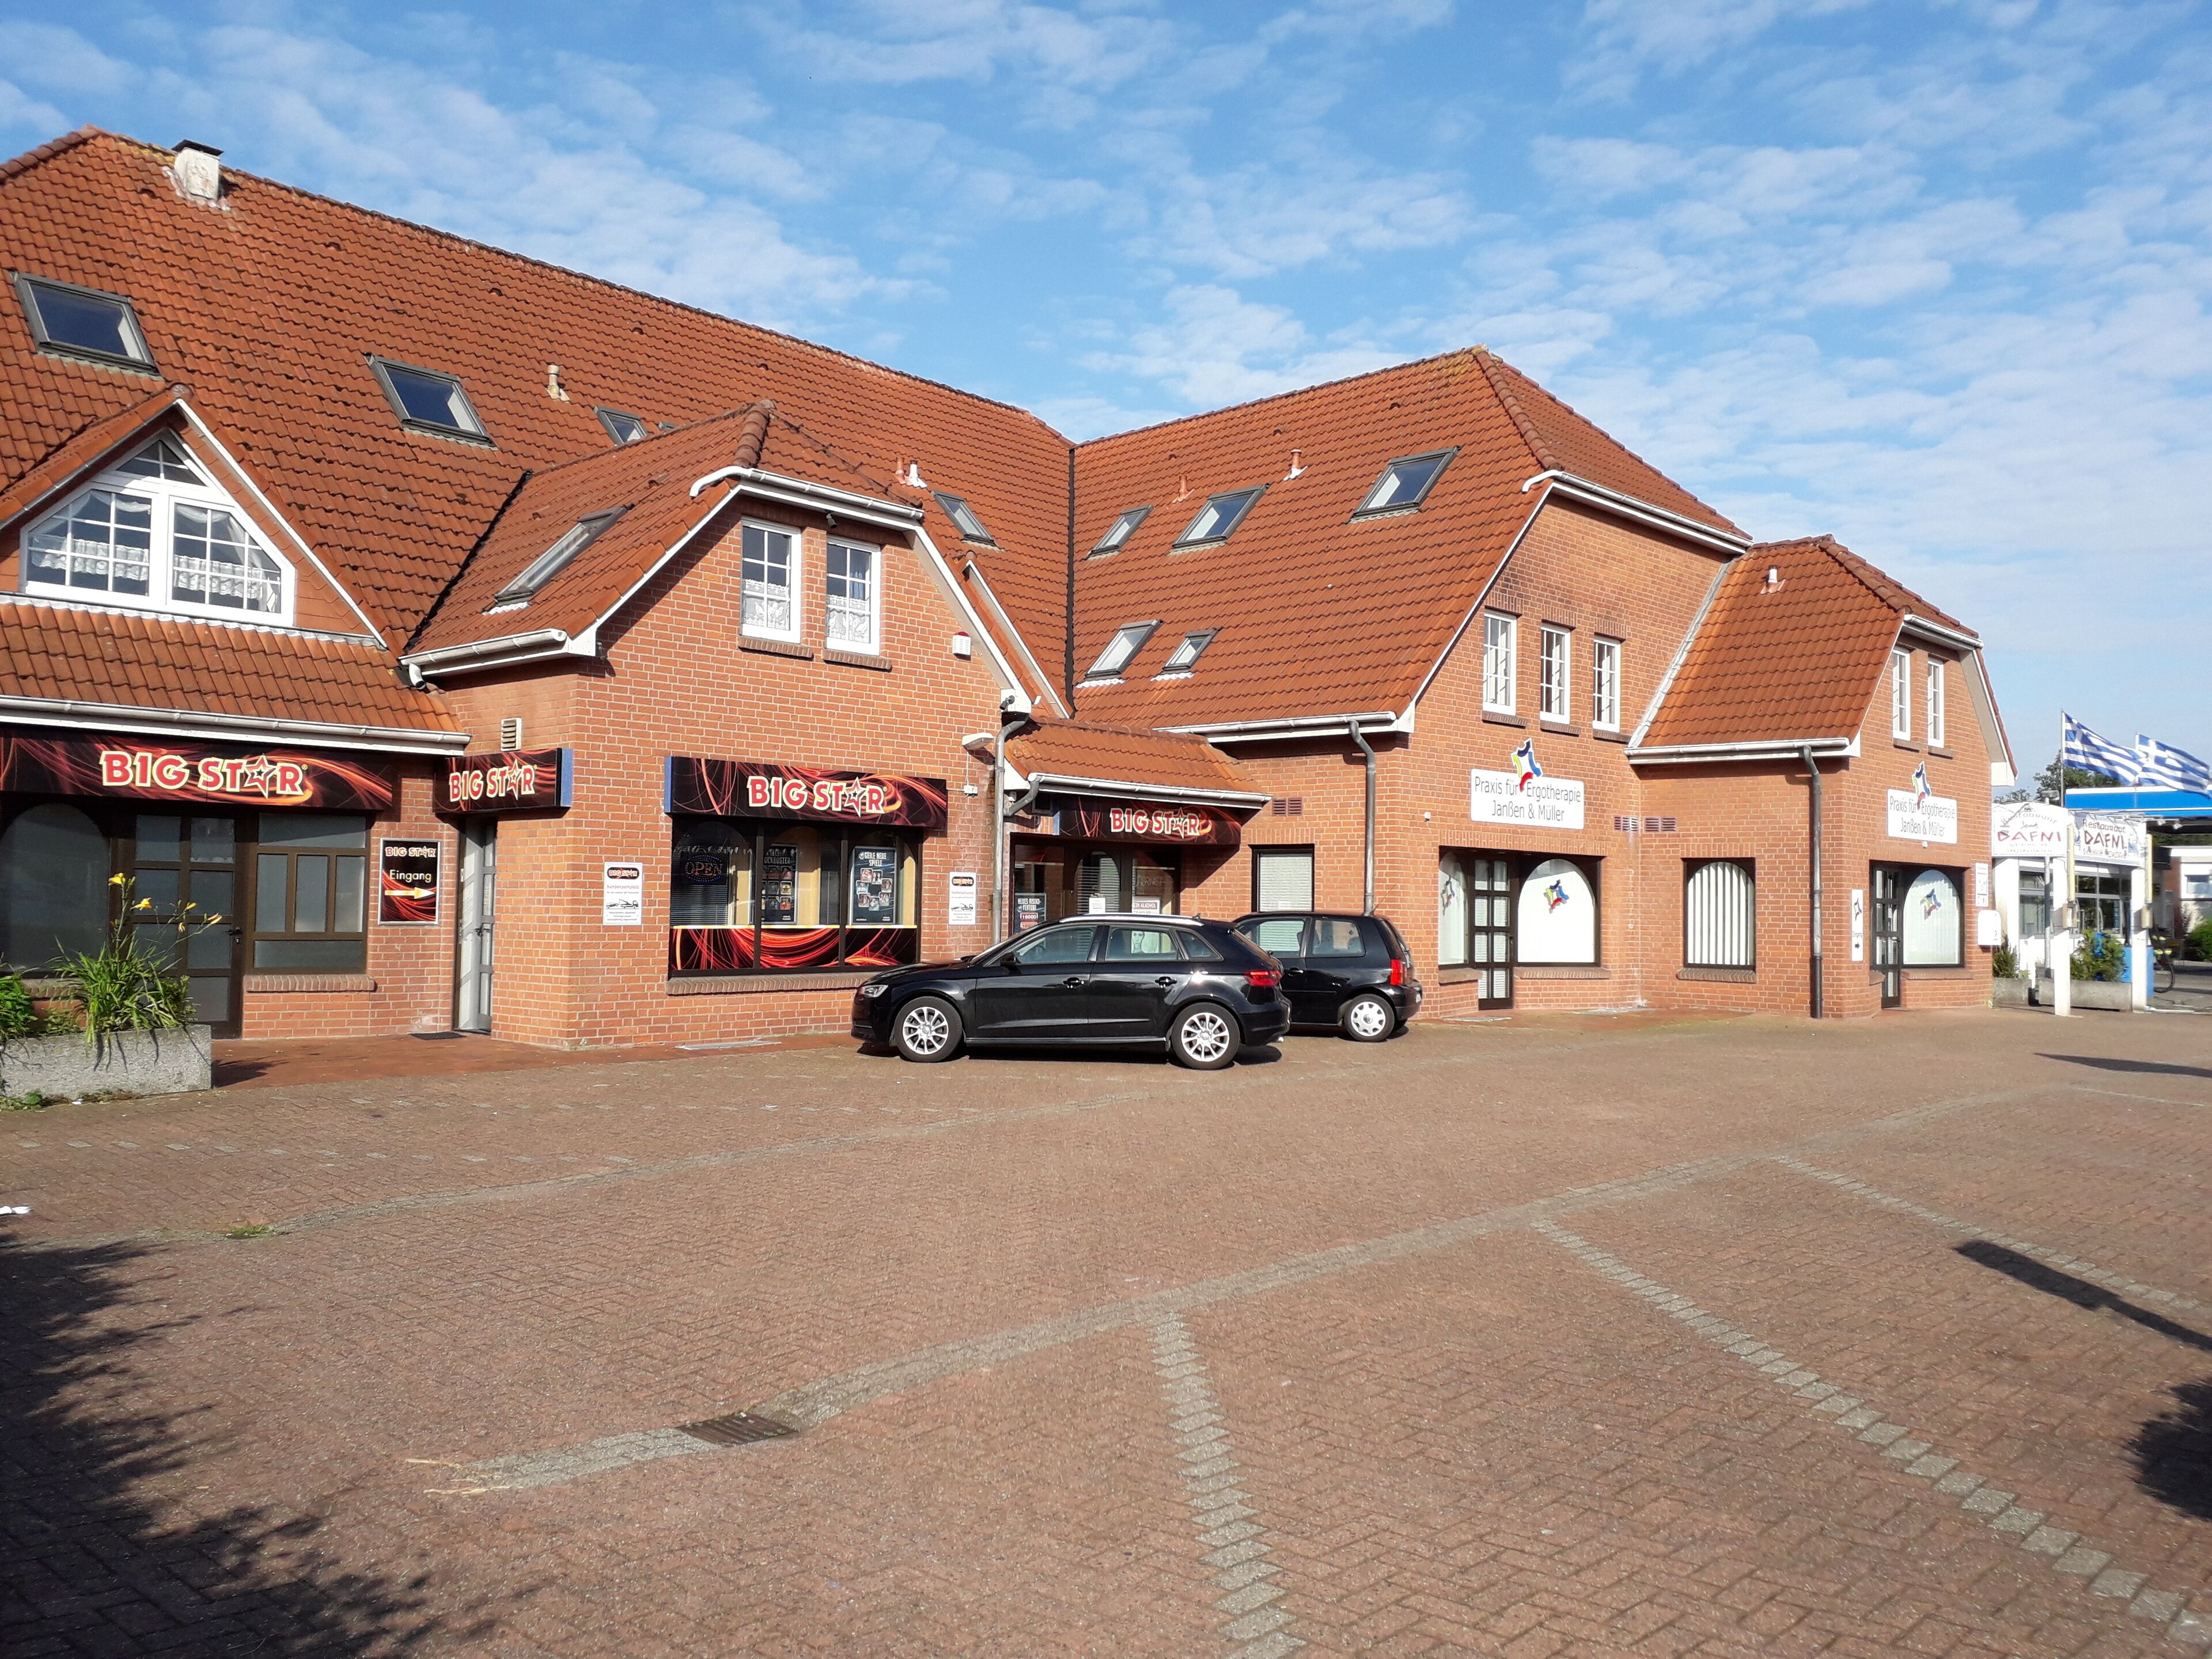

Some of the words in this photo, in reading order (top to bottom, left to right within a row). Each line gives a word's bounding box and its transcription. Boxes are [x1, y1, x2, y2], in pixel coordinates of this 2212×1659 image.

[99, 751, 190, 790] BIG
[449, 770, 483, 802] BIG
[747, 775, 807, 809] BIG
[1475, 776, 1503, 794] Praxis
[1505, 779, 1518, 796] für
[1527, 781, 1581, 805] Ergotherapie
[1492, 800, 1524, 818] Janßen
[1528, 803, 1535, 819] &
[1539, 804, 1565, 821] Müller
[1889, 796, 1907, 812] Praxis
[1908, 798, 1917, 813] für
[1921, 801, 1955, 820] Ergotherapie
[1109, 808, 1149, 834] BIG
[1900, 817, 1921, 834] Janßen
[1922, 820, 1927, 835] &
[1929, 821, 1945, 837] Müller
[1997, 831, 2062, 842] DAFNI
[2084, 830, 2124, 850] DAFNI
[385, 847, 407, 857] BIG
[389, 869, 431, 883] Eingang
